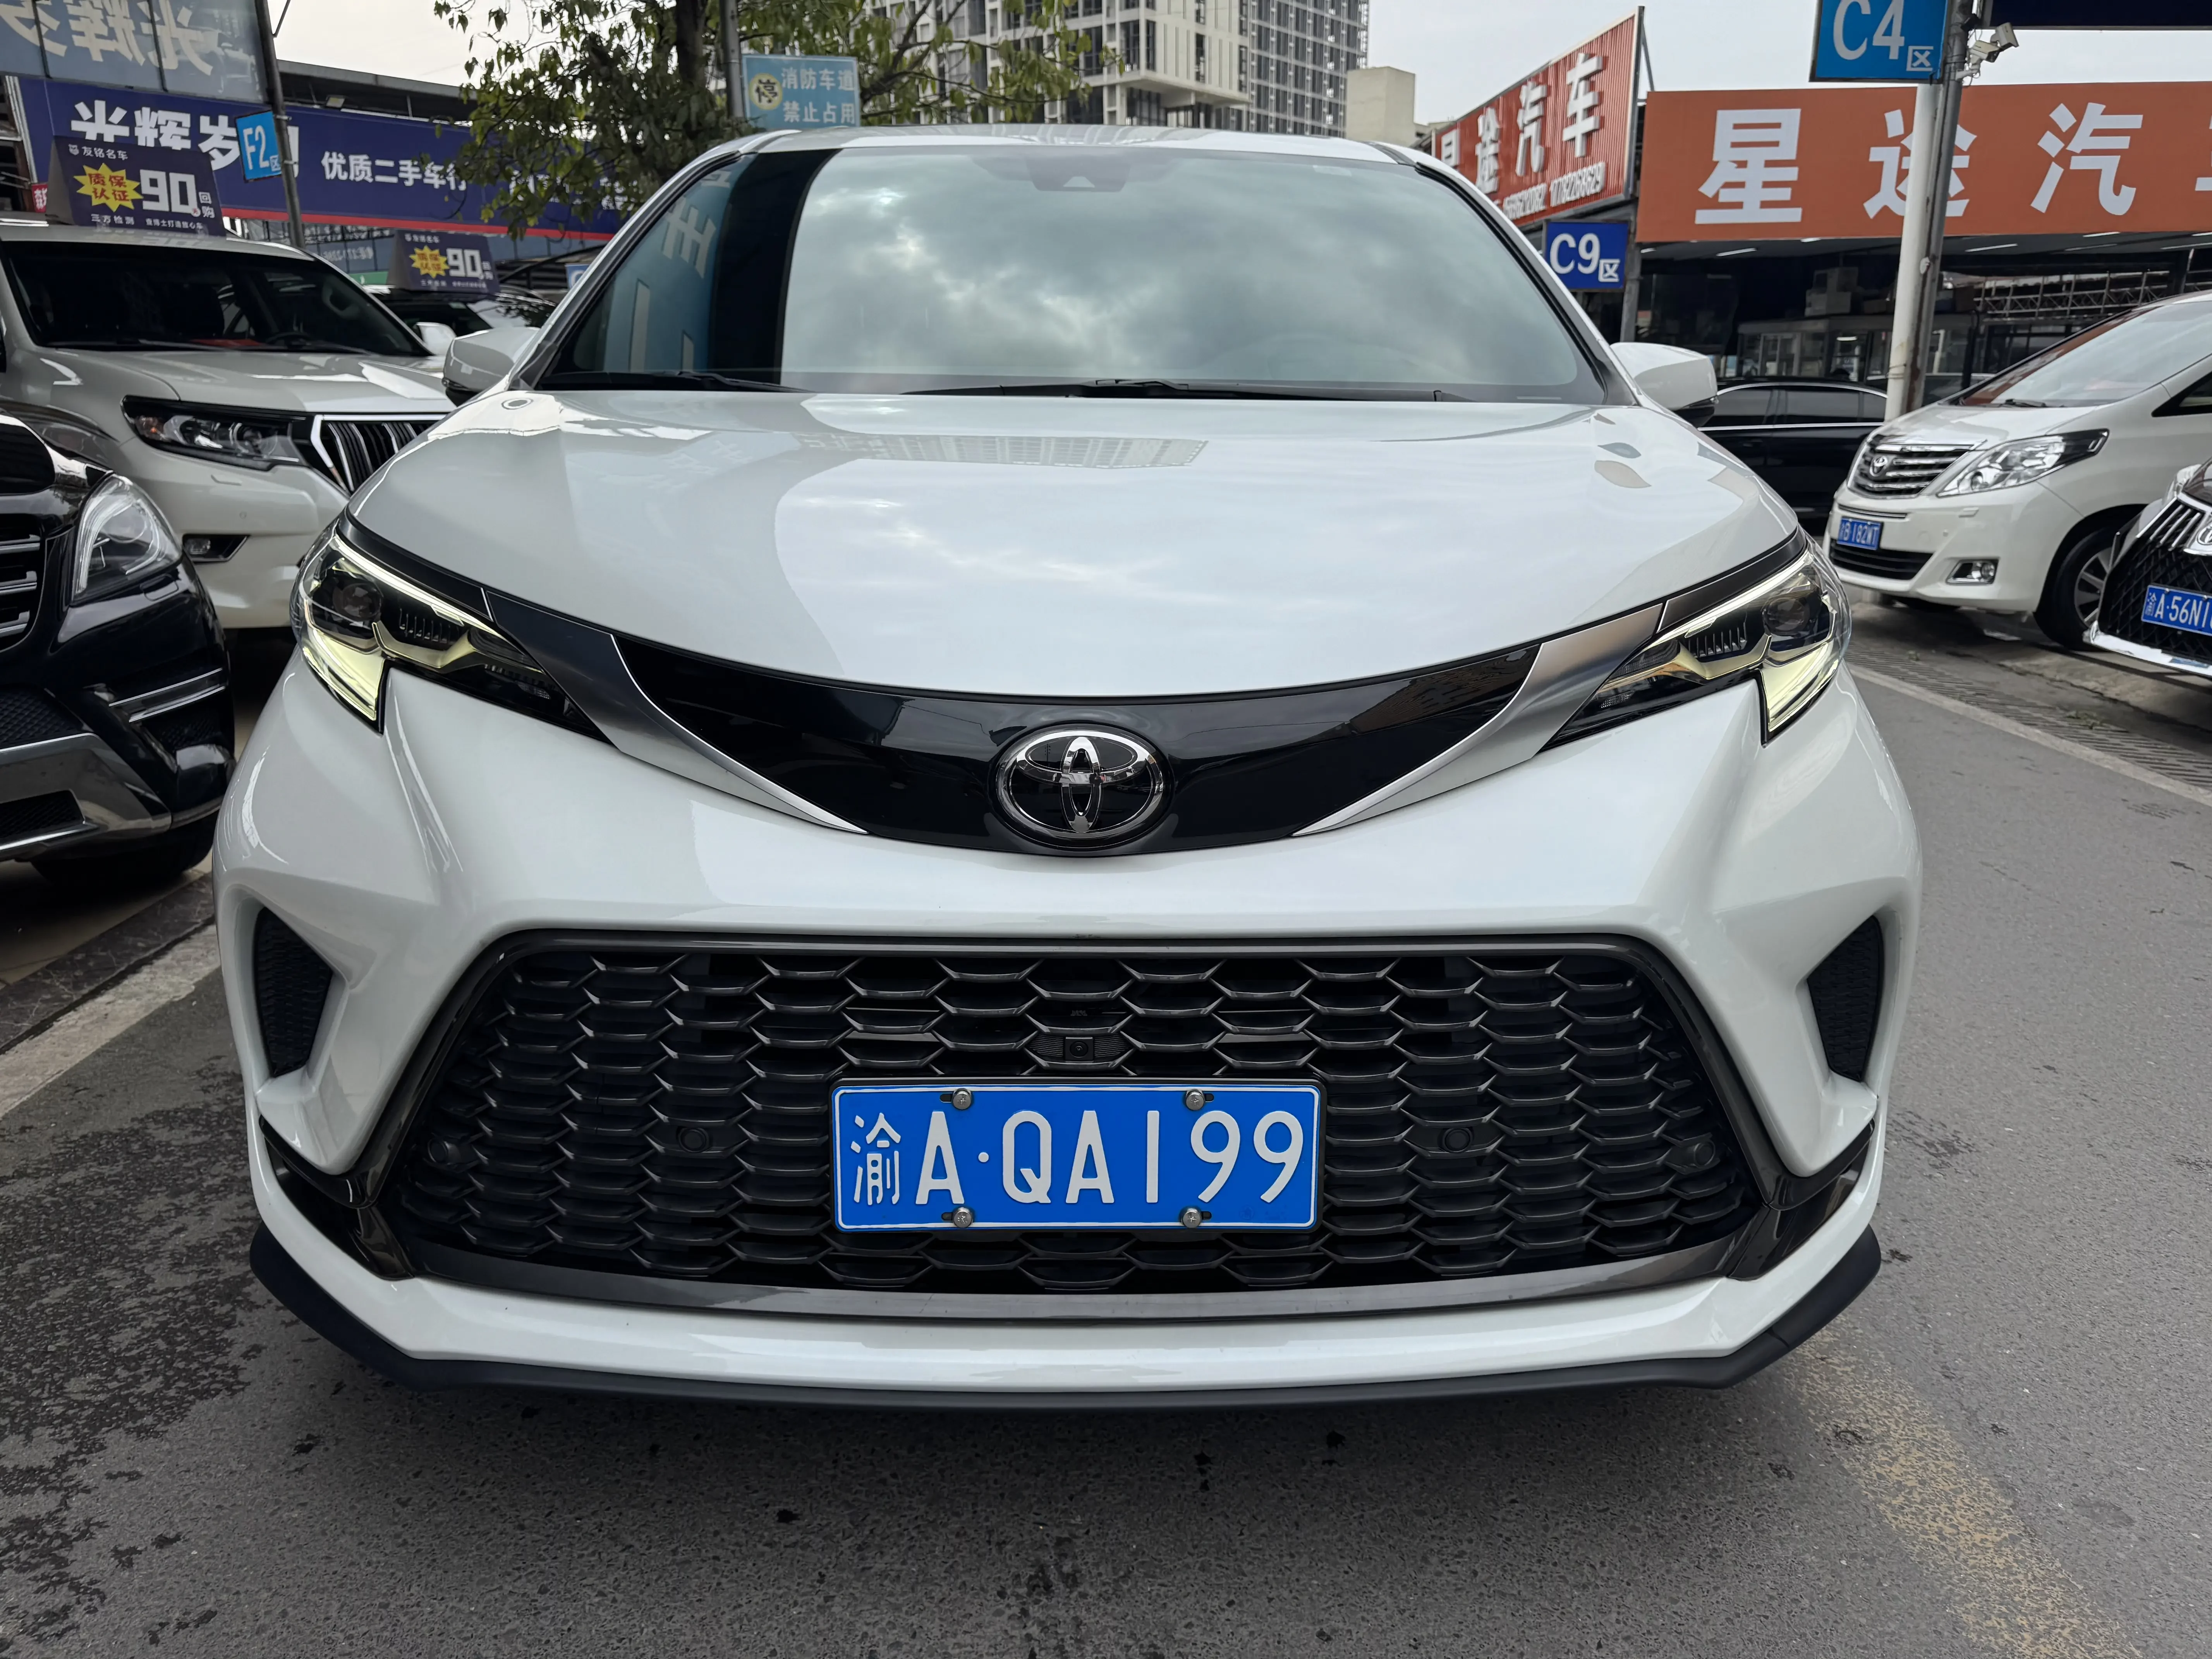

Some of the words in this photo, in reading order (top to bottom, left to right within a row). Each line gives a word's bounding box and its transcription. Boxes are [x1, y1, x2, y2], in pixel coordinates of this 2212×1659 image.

[1833, 0, 1934, 71] C4区
[781, 67, 855, 91] 消防车道
[783, 101, 855, 124] 禁止占用
[71, 100, 299, 178] 光辉岁
[243, 125, 282, 172] F2区
[88, 173, 127, 188] 质保
[1695, 102, 2212, 224] 星途汽
[93, 187, 132, 202] 认证
[140, 169, 198, 214] 90
[446, 248, 483, 277] 90
[1550, 233, 1620, 282] C9区
[2144, 592, 2212, 630] 渝A·56N1
[851, 1110, 1304, 1206] 渝A·QA199
